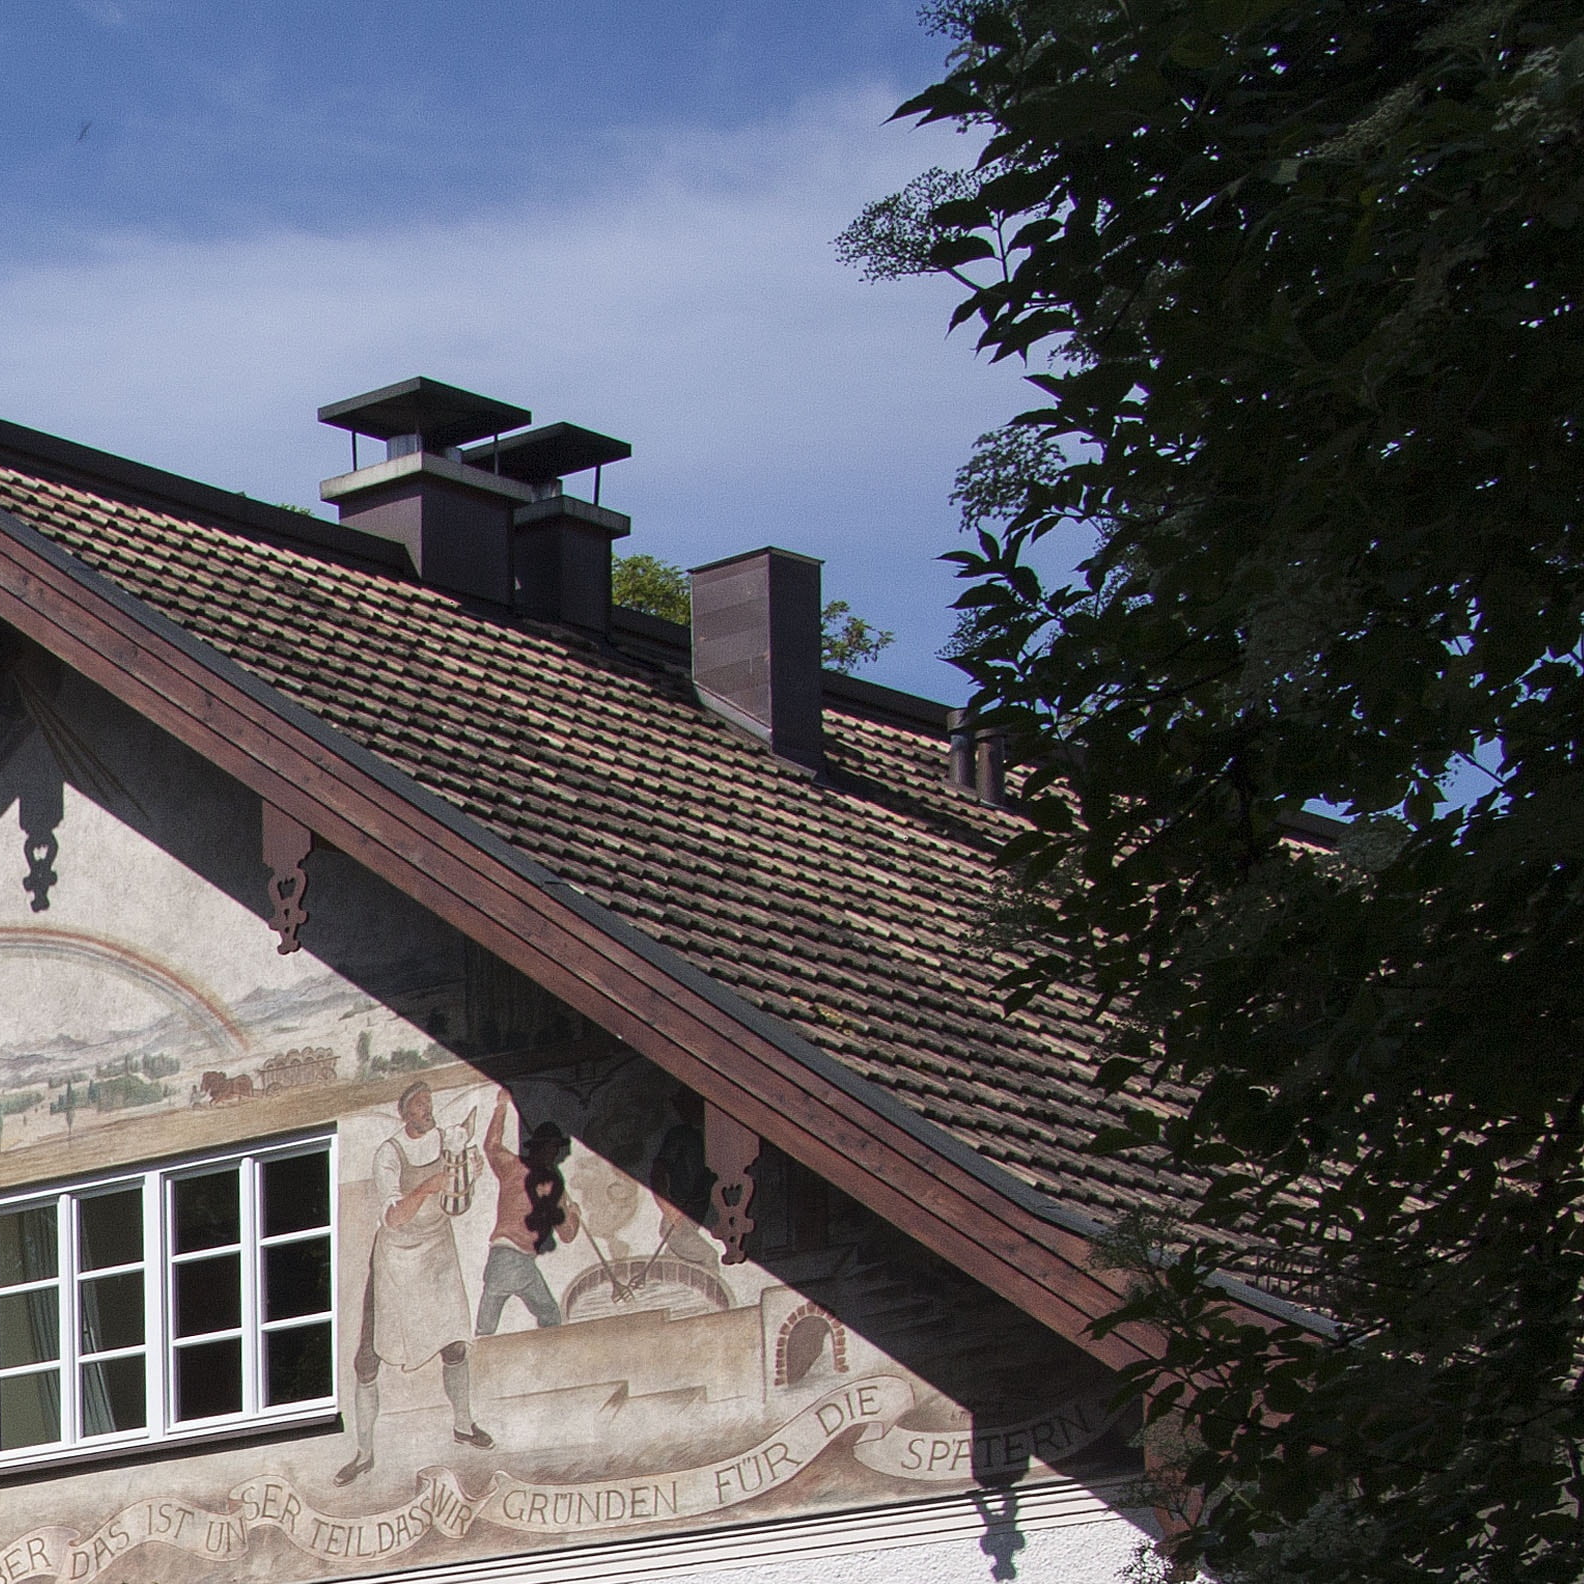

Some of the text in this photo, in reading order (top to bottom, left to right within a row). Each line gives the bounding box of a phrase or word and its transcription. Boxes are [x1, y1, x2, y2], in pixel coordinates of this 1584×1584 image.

[69, 1520, 131, 1581] DAS
[146, 1502, 195, 1540] IST
[376, 1496, 433, 1555] DASS
[430, 1478, 473, 1537] WIR
[502, 1479, 680, 1526] GRÜNDEN
[714, 1441, 805, 1505] FÜR
[815, 1385, 884, 1438] DIE
